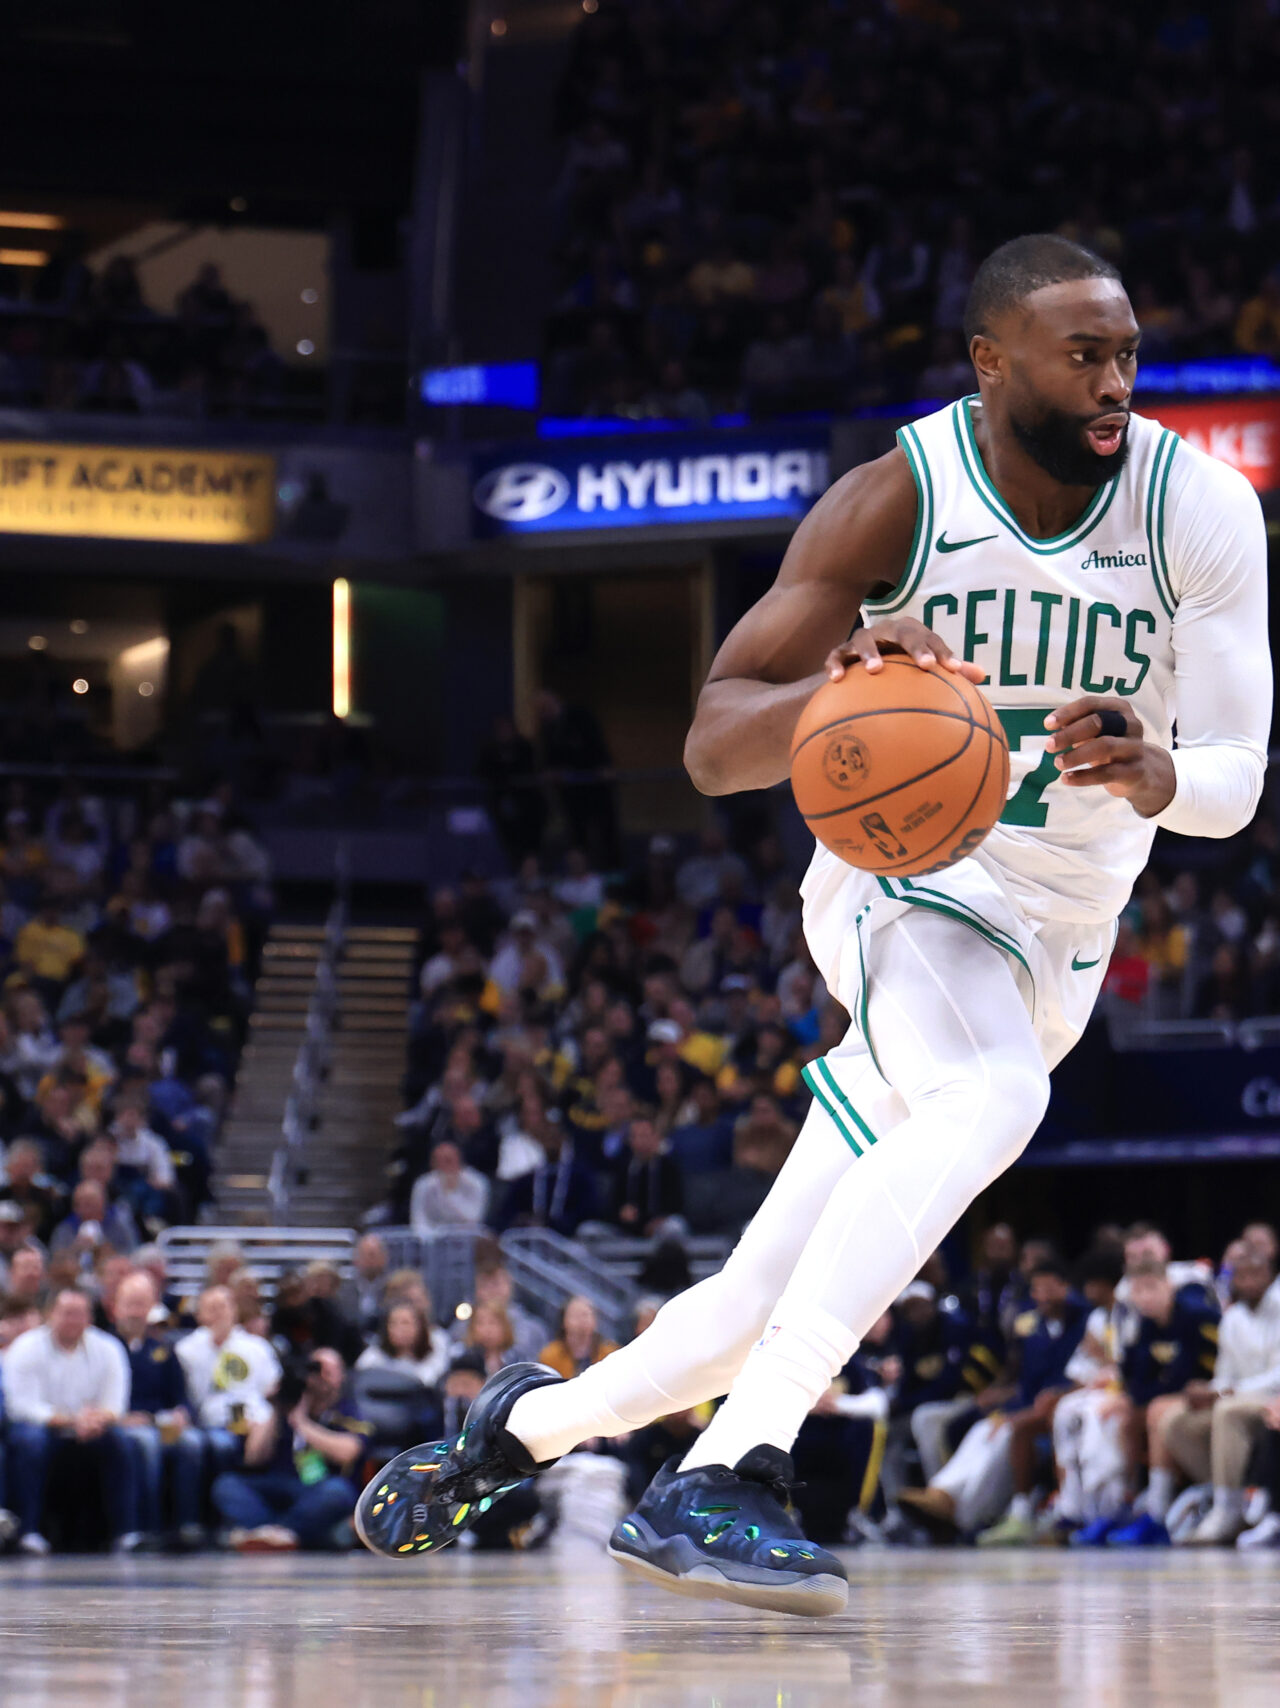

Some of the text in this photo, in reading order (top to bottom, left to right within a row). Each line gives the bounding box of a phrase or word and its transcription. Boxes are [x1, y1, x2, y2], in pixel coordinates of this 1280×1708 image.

[70, 458, 262, 498] ACADEMY
[577, 450, 829, 513] HYUNDAI
[1081, 549, 1147, 570] Amica
[923, 589, 1156, 696] CELTICS
[994, 709, 1074, 828] 7
